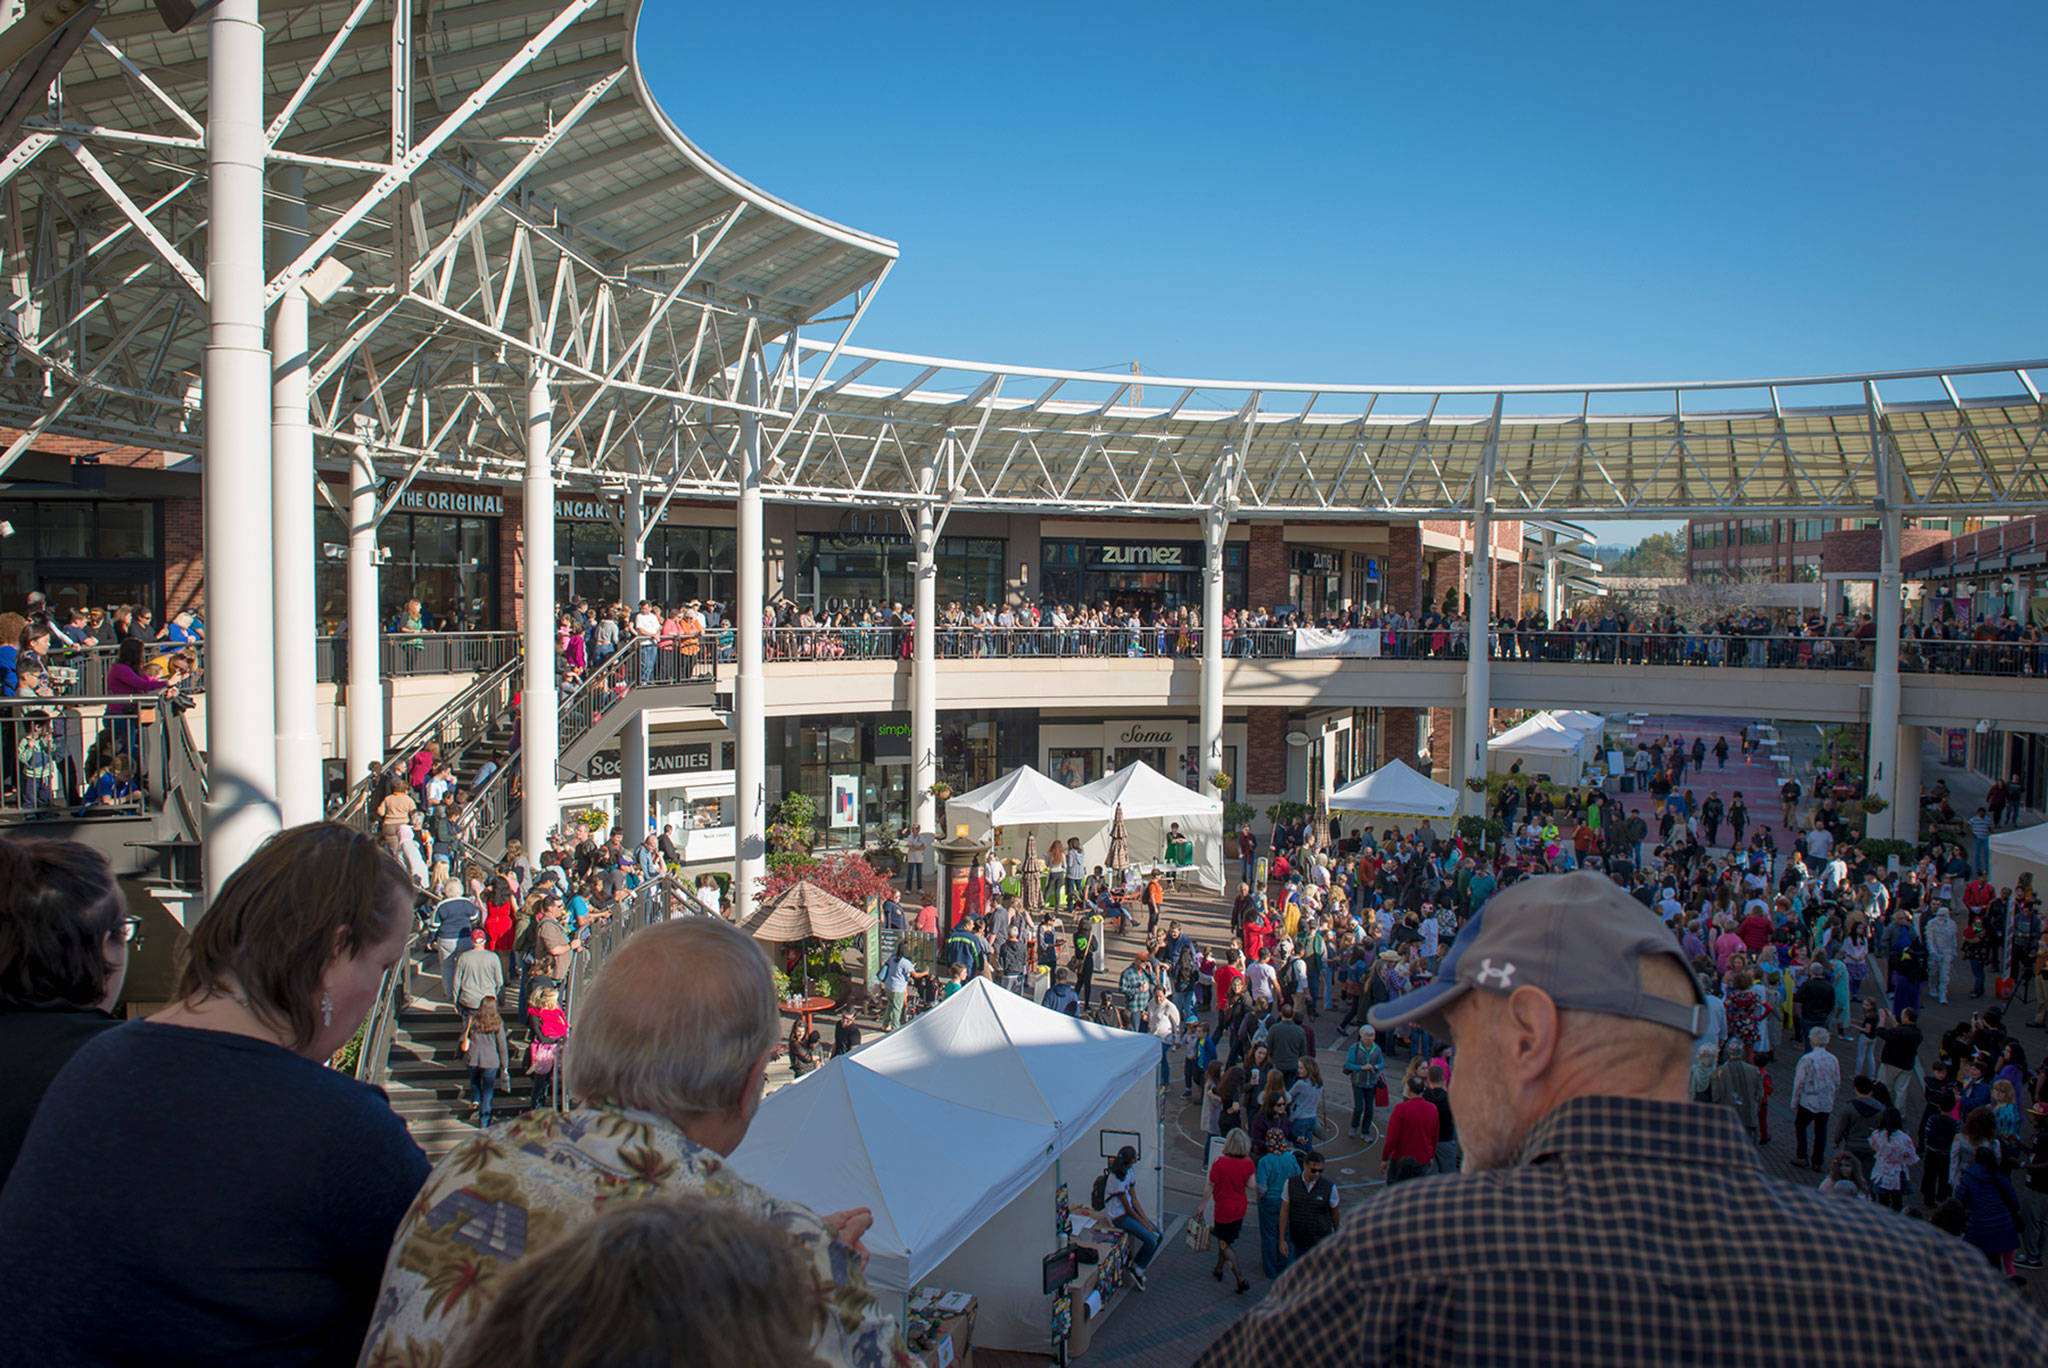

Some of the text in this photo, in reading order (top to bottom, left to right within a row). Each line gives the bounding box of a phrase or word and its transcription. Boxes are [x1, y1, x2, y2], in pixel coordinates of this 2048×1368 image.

[400, 491, 504, 513] THE ORIGINAL
[554, 500, 613, 519] ANCAK
[862, 534, 914, 545] EYEWEA
[1102, 545, 1182, 565] zumiez
[878, 723, 912, 737] simply
[1120, 724, 1173, 744] Soma
